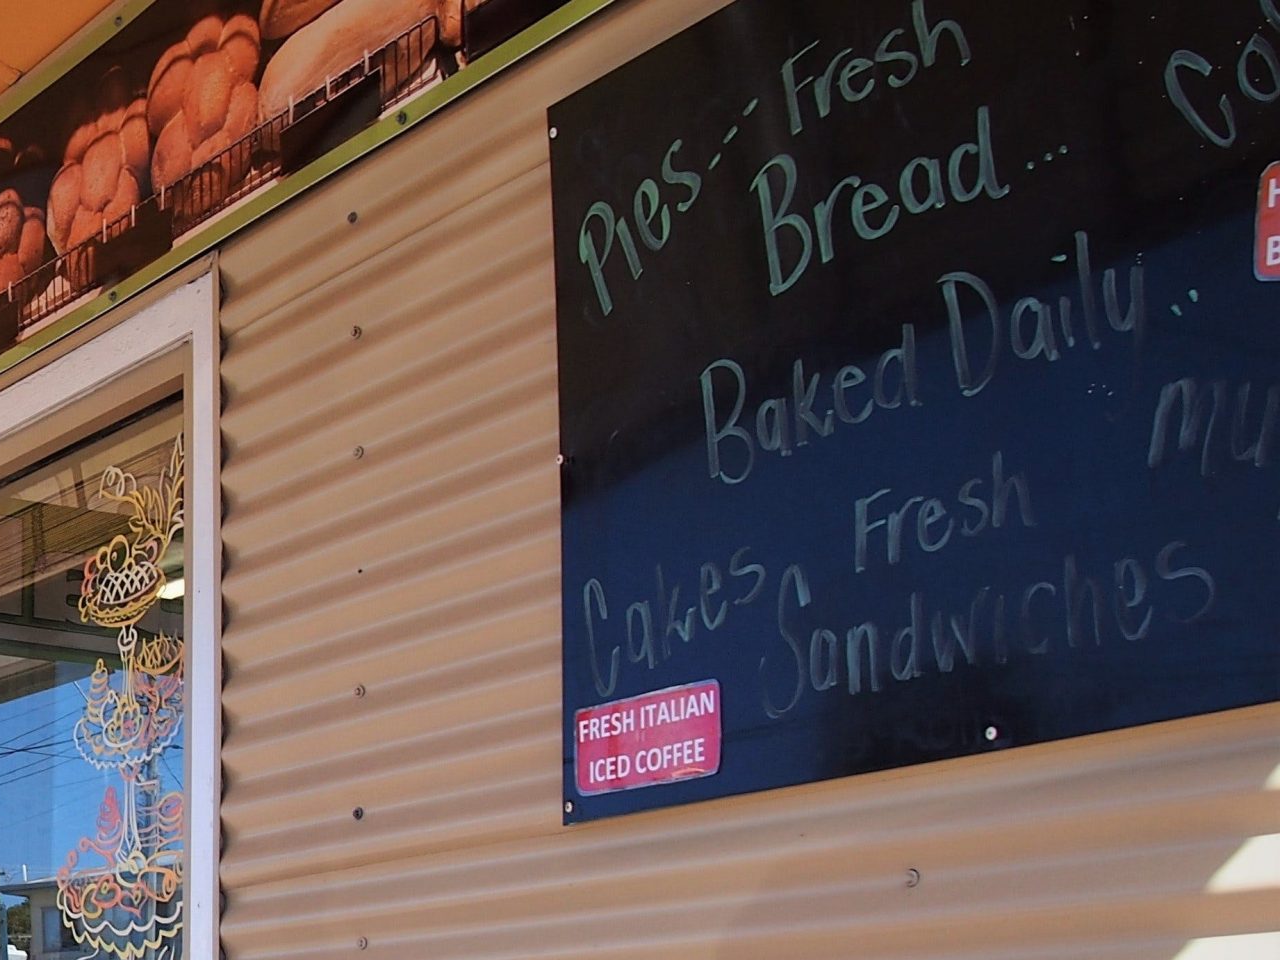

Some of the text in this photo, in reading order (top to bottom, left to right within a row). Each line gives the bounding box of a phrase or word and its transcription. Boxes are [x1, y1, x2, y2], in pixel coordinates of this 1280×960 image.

[781, 0, 972, 135] Fresh
[700, 323, 923, 484] Baked
[581, 449, 1036, 698] Cakes Fresh
[759, 540, 1216, 720] Sandwiches
[578, 690, 715, 744] FRESH ITALIAN
[589, 737, 706, 784] ICED COFFEE
